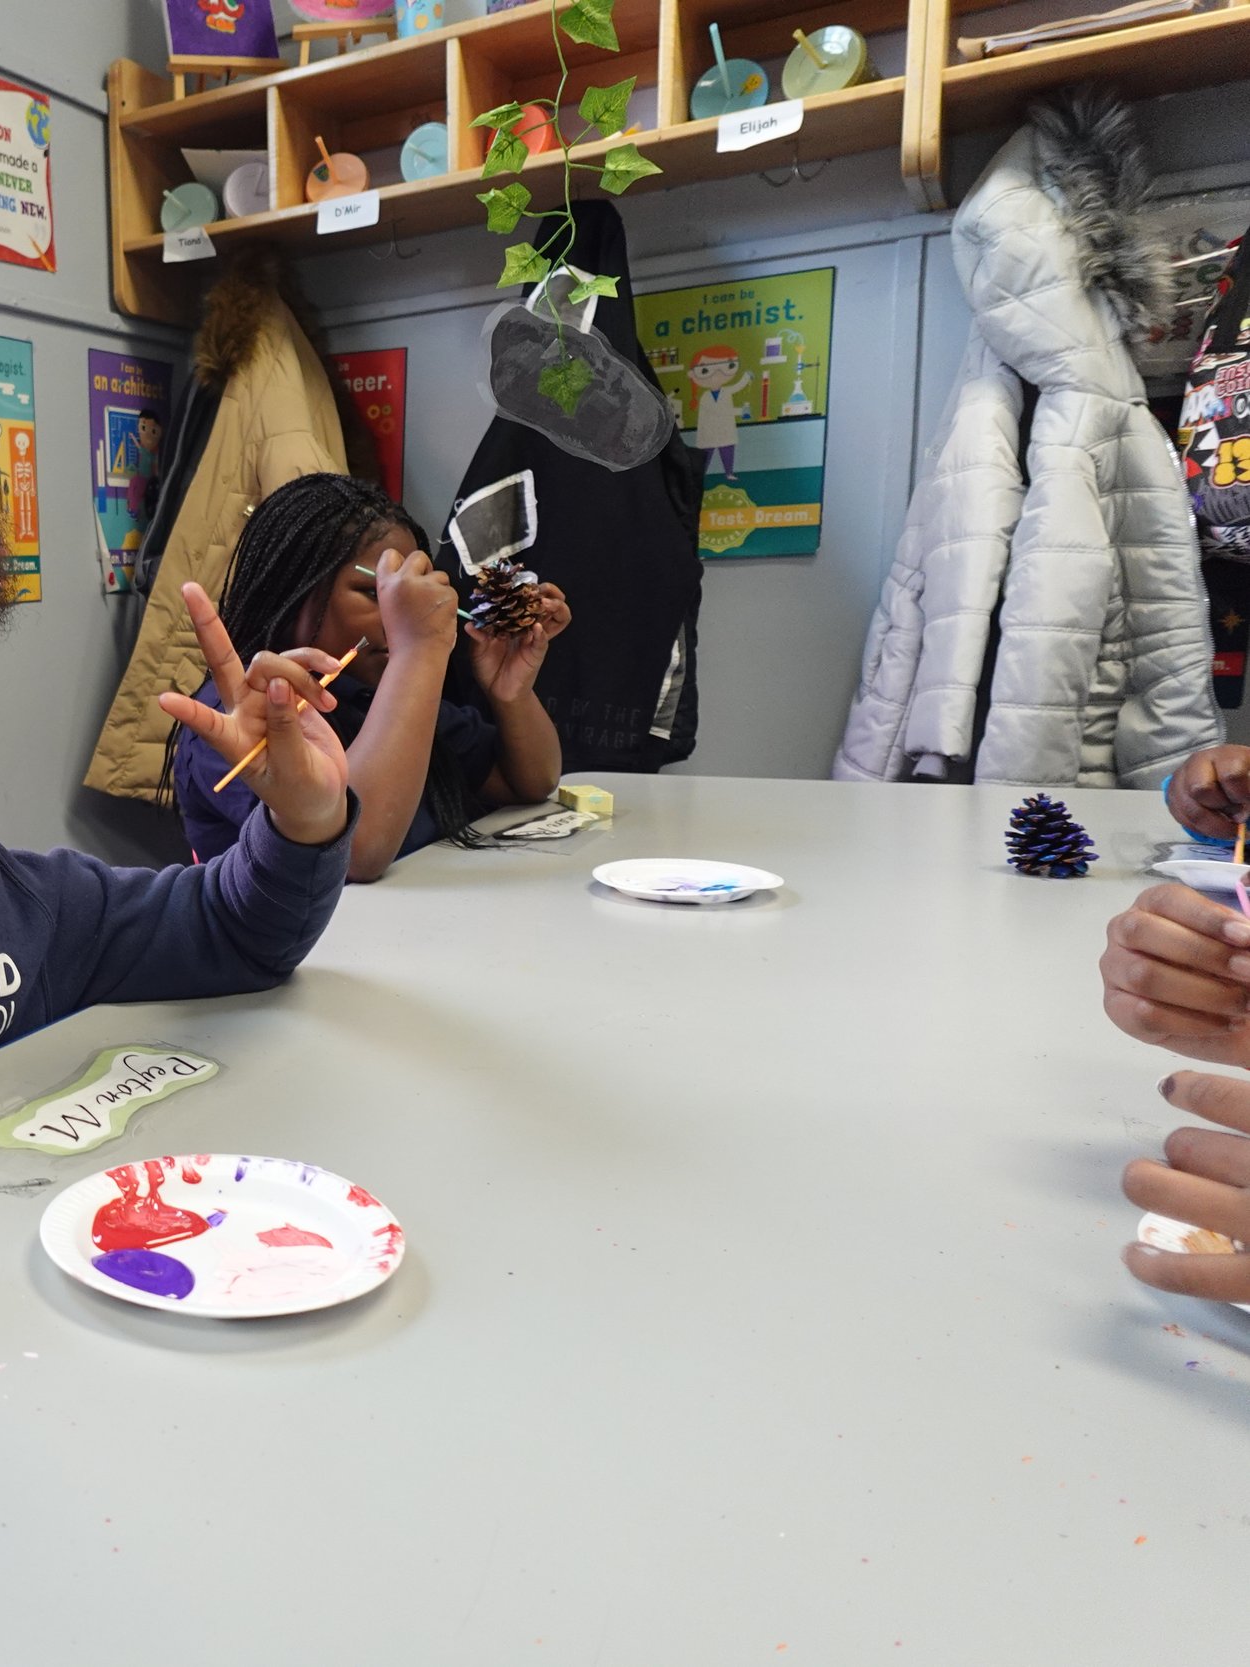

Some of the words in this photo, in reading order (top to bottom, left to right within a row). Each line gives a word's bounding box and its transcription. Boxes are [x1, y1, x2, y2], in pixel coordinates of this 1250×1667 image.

[740, 117, 778, 135] Elijah
[0, 152, 29, 171] made
[31, 163, 38, 173] a
[20, 200, 47, 220] NEW.
[334, 204, 362, 217] D'Mir
[177, 237, 202, 248] Tiana
[711, 291, 735, 303] can
[740, 288, 755, 301] be
[655, 320, 670, 337] a
[682, 298, 803, 335] chemist.
[93, 374, 108, 391] an
[709, 511, 749, 526] Test.
[755, 508, 813, 524] Dream.
[96, 1054, 206, 1105] Peyton
[29, 1103, 101, 1142] M.
